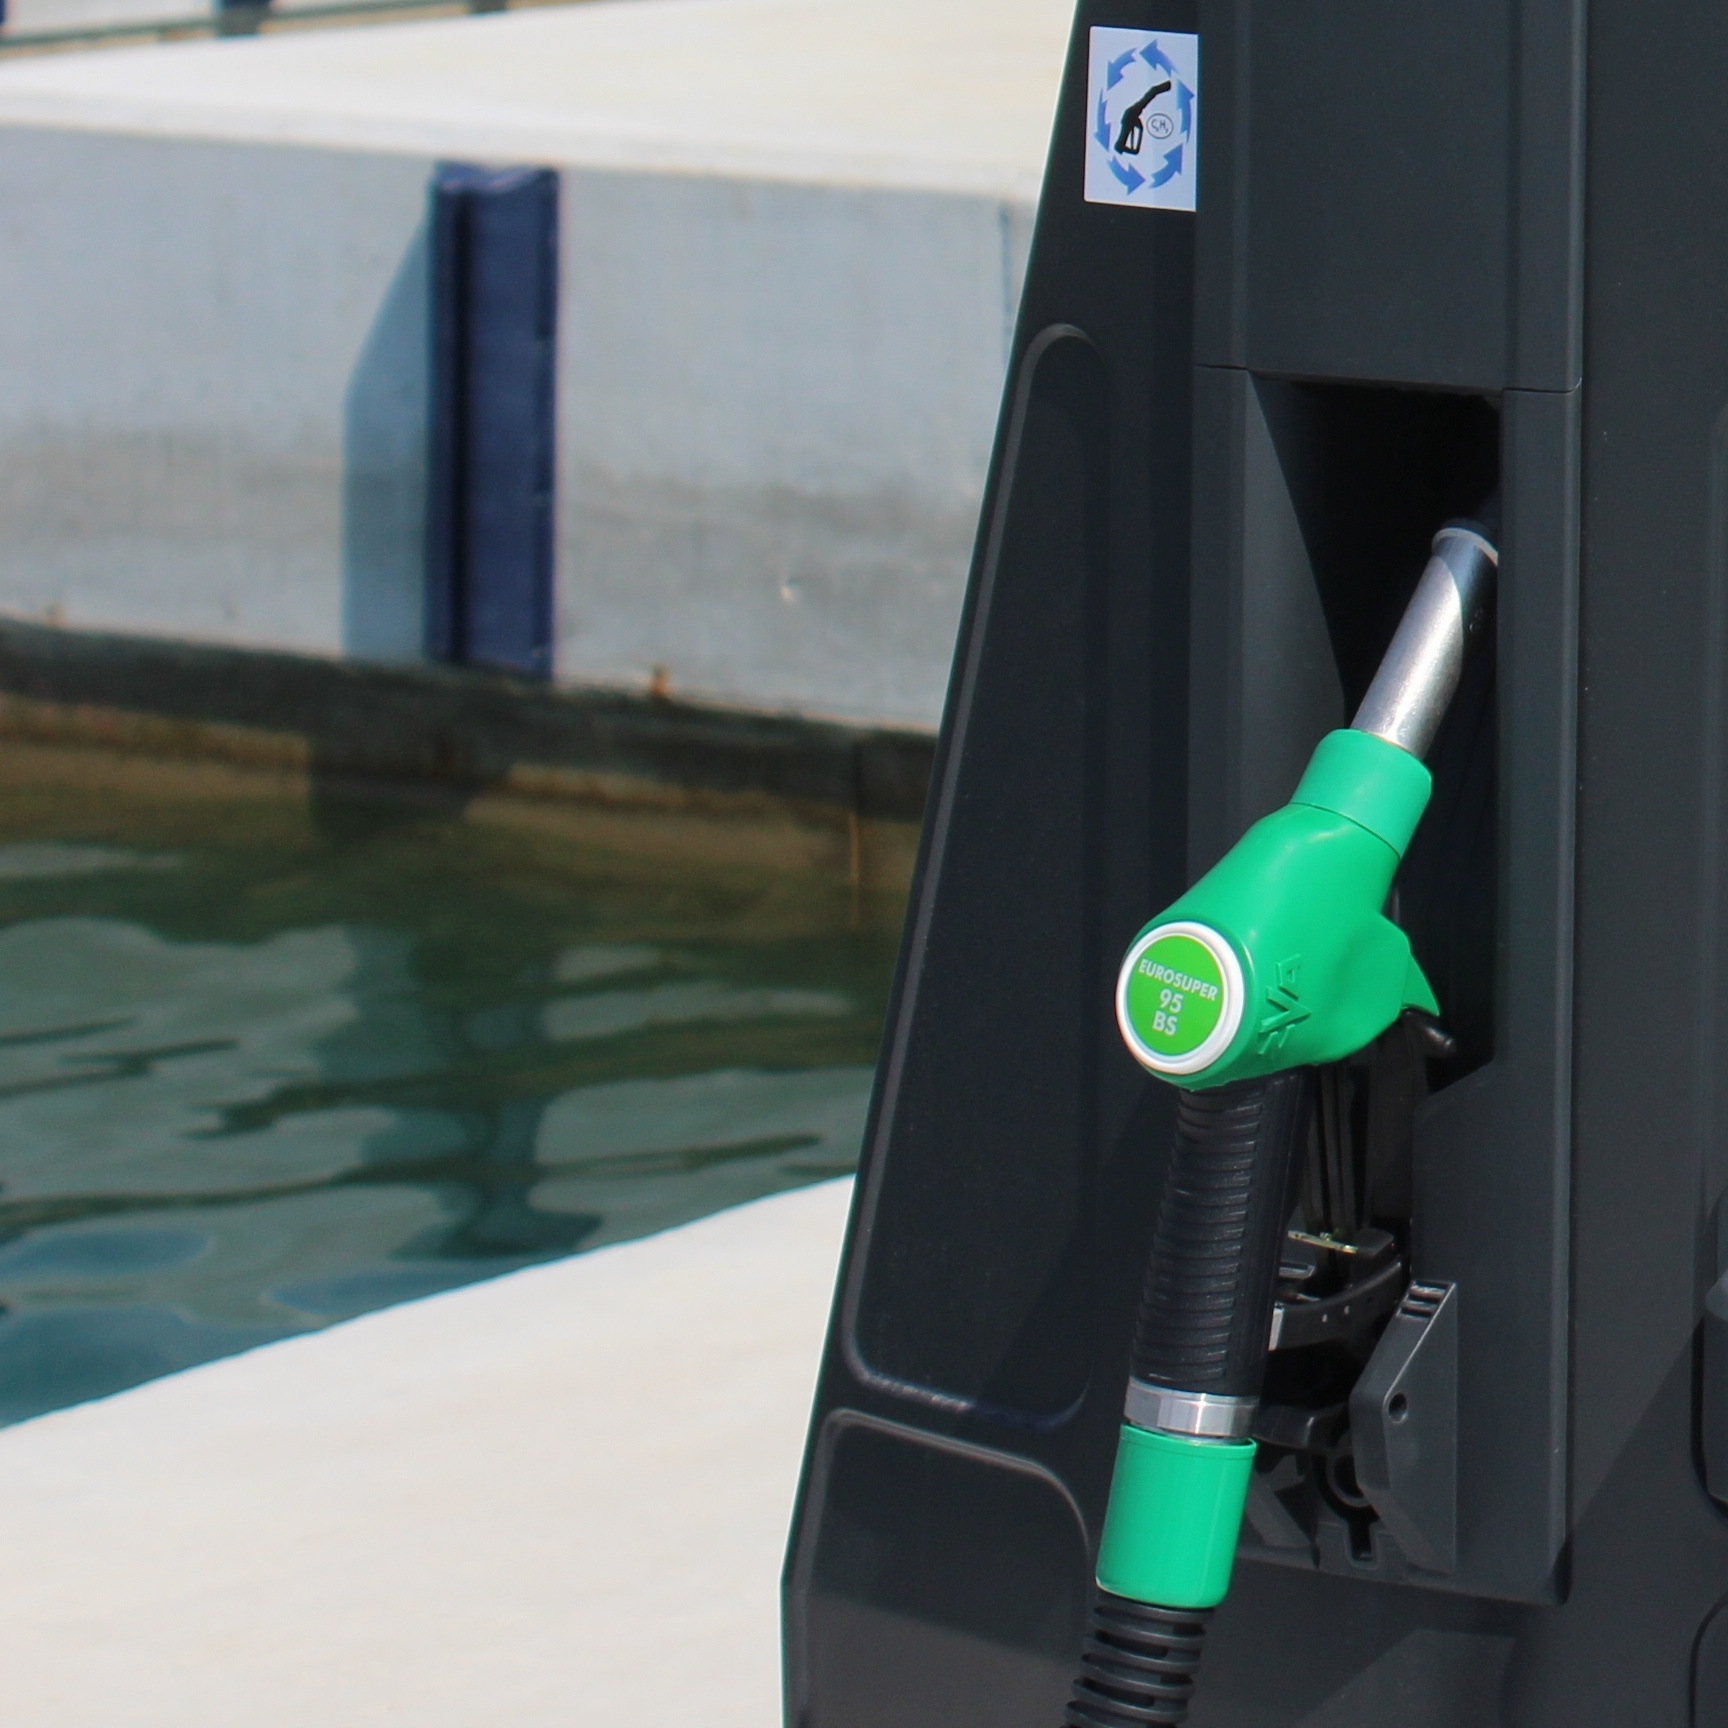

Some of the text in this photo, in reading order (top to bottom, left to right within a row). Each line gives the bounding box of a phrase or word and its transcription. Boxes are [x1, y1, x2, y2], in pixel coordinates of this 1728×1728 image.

[1138, 958, 1218, 1001] EUROSUPER
[1160, 988, 1184, 1014] 95
[1152, 1010, 1178, 1036] BS
